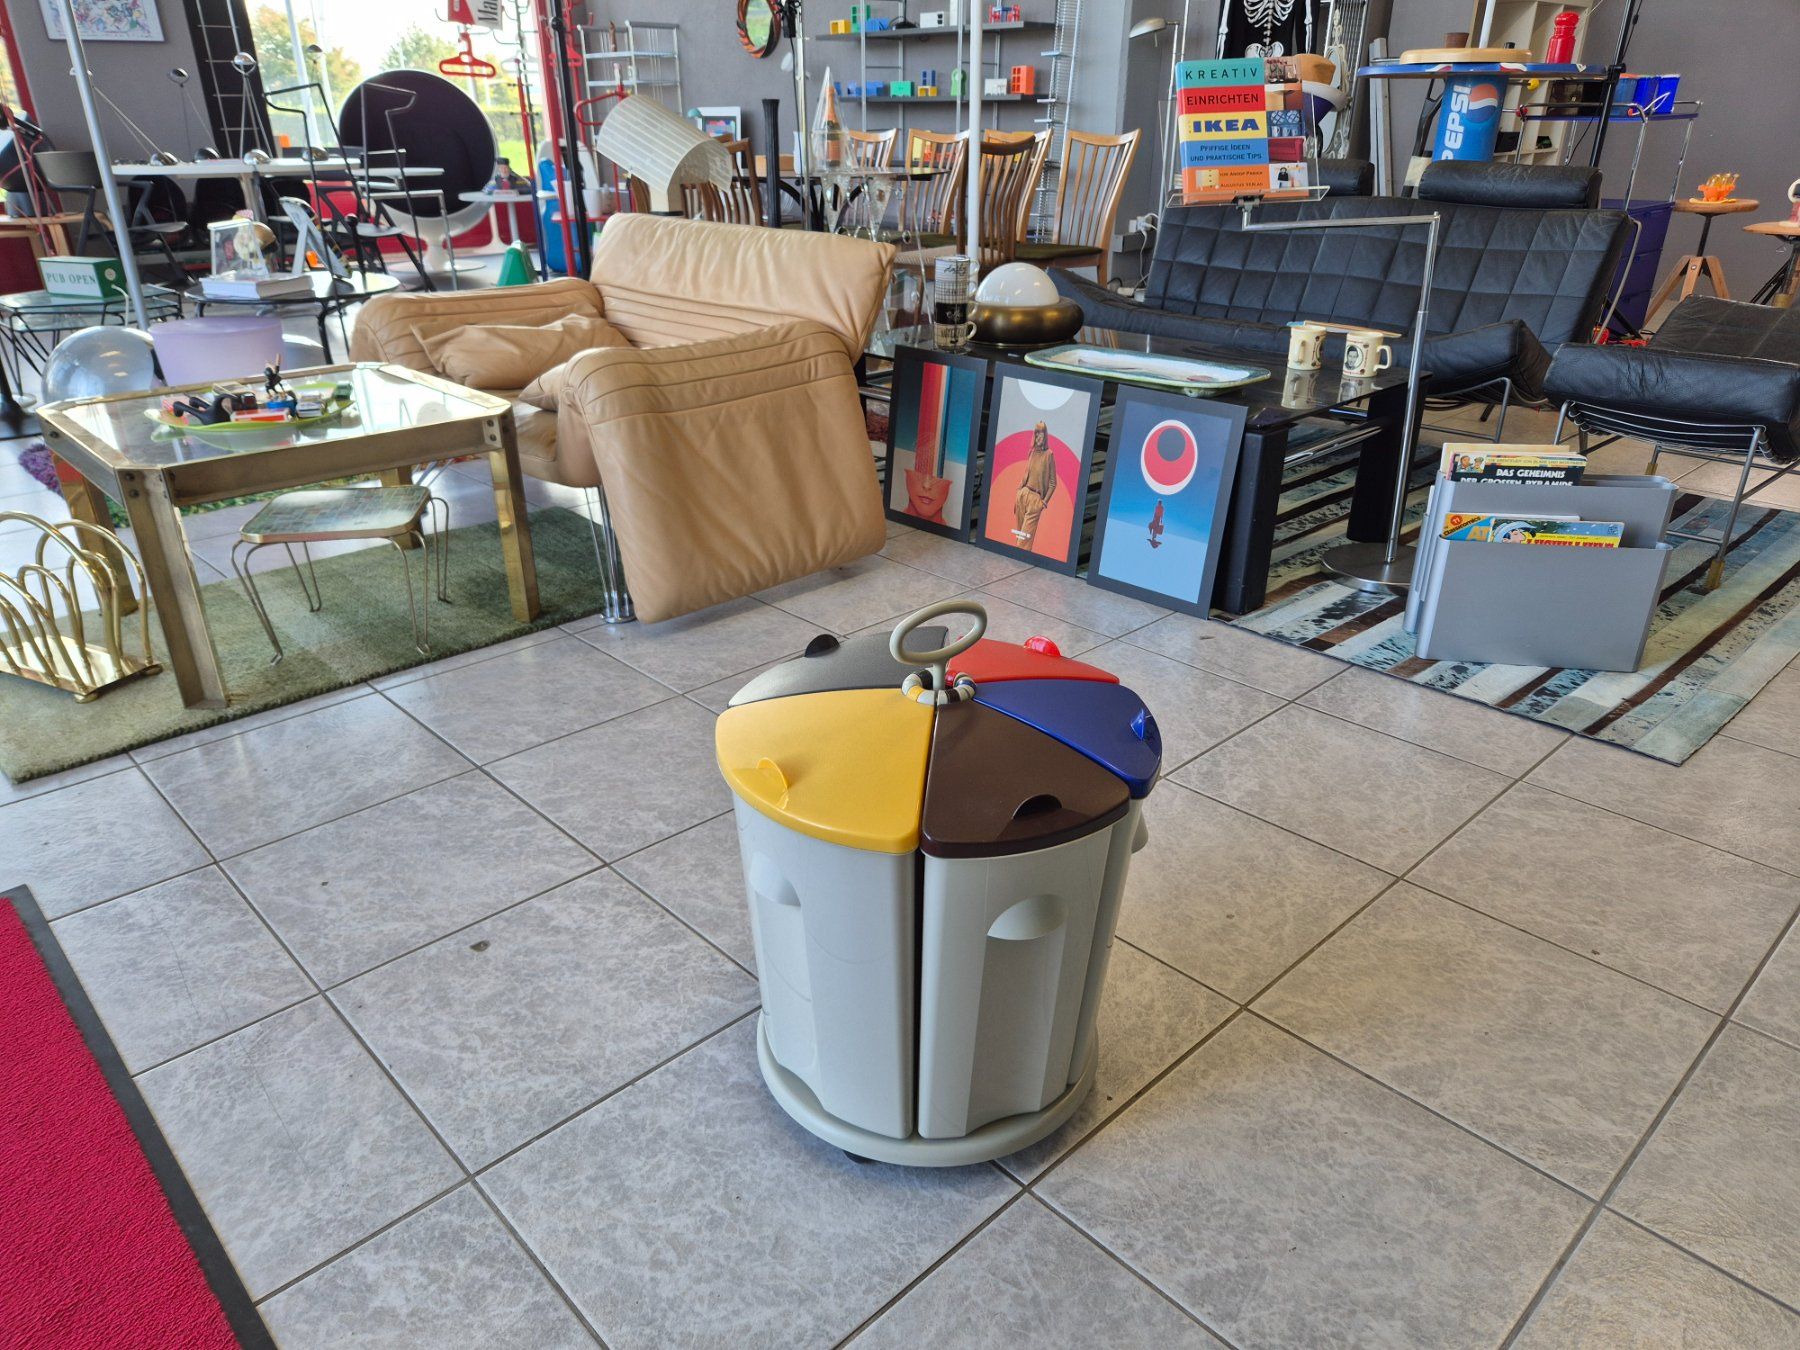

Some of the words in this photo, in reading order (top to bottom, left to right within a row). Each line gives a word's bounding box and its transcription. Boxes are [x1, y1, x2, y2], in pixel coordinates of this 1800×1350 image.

[1185, 68, 1257, 79] KREATIV
[1187, 93, 1259, 105] EINRICHTEN
[1193, 119, 1259, 132] IKEA
[1206, 153, 1245, 161] PRAKTISCHE
[45, 272, 65, 283] PUB
[68, 273, 96, 284] OPEN
[1496, 468, 1513, 477] DAS
[1516, 469, 1565, 479] GEHEIMNIS
